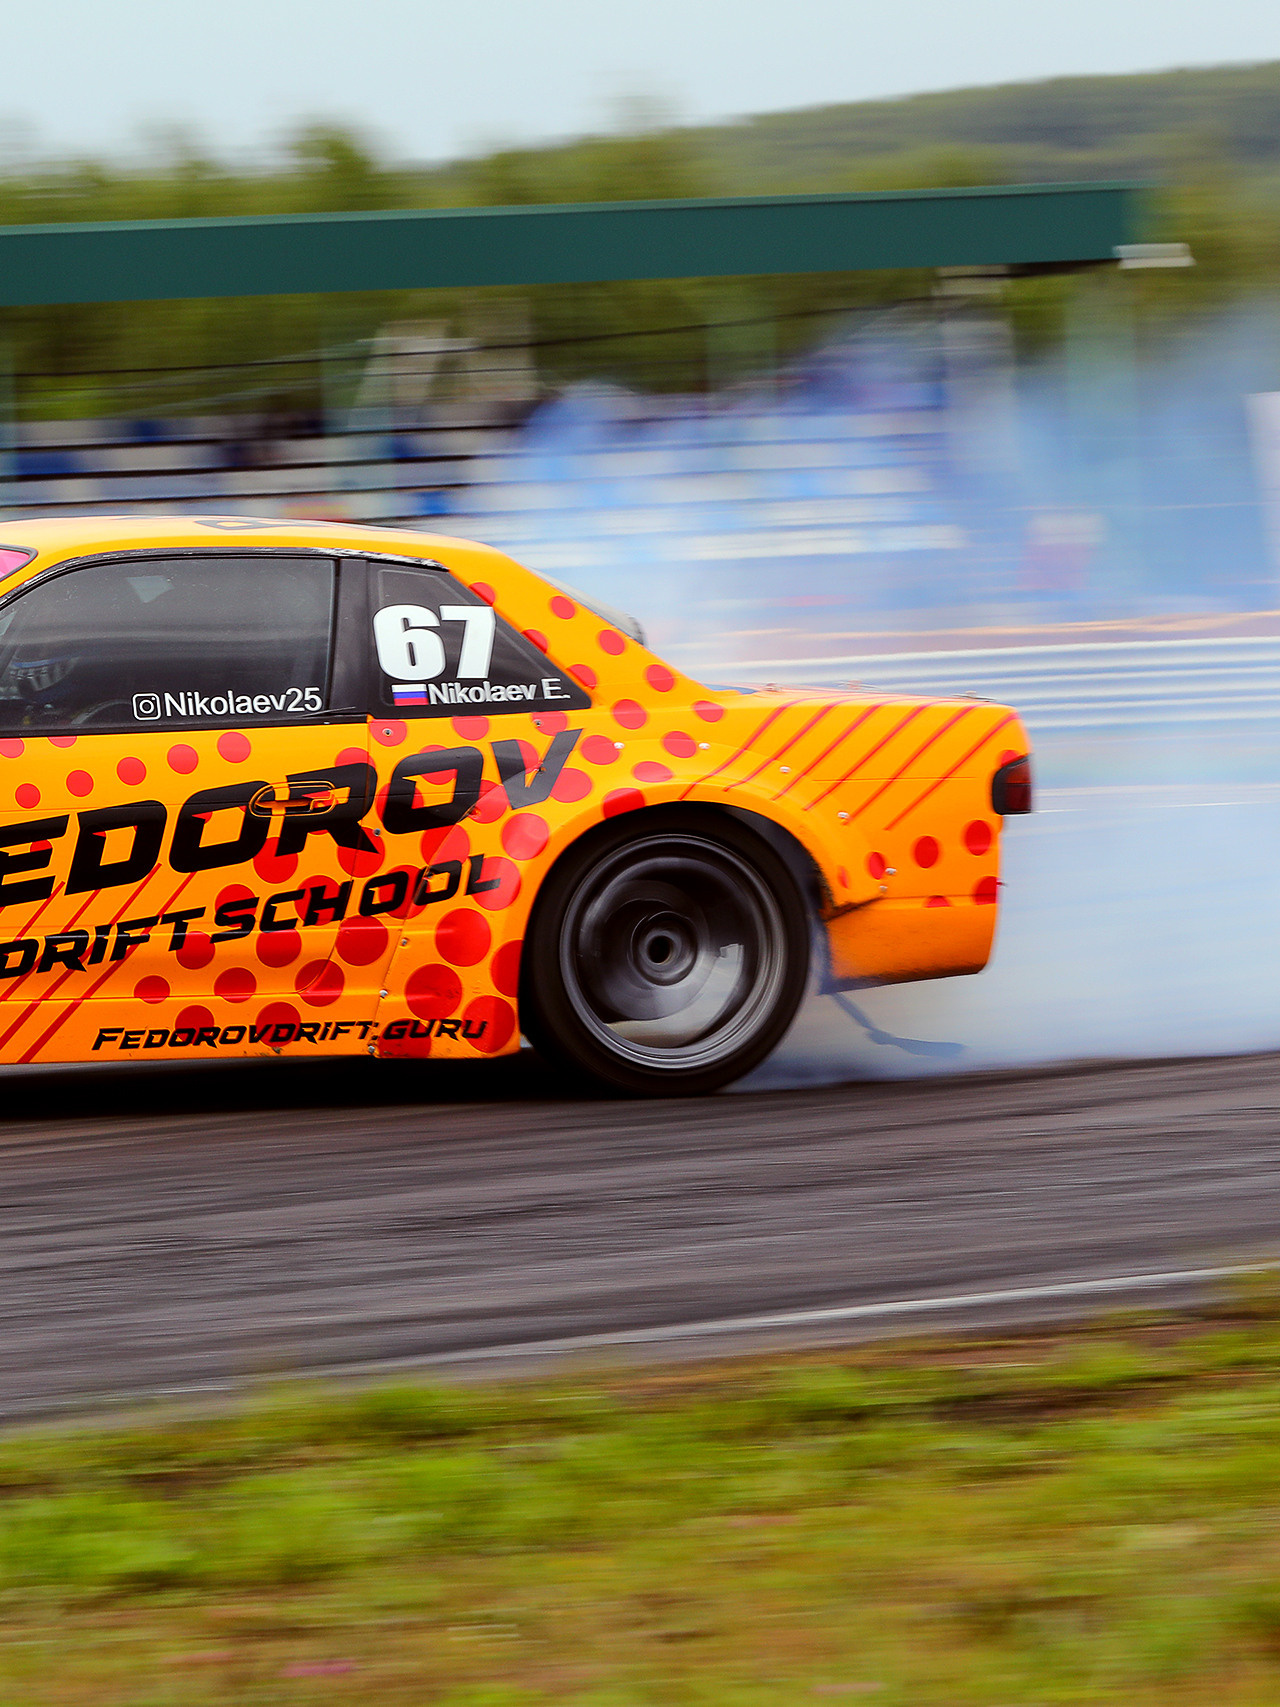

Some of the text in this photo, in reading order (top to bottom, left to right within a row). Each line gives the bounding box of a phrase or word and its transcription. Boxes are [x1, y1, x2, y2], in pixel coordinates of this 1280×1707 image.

[373, 604, 497, 682] 67
[165, 687, 323, 717] Nikolaev25
[428, 678, 571, 705] Nikolaev E.
